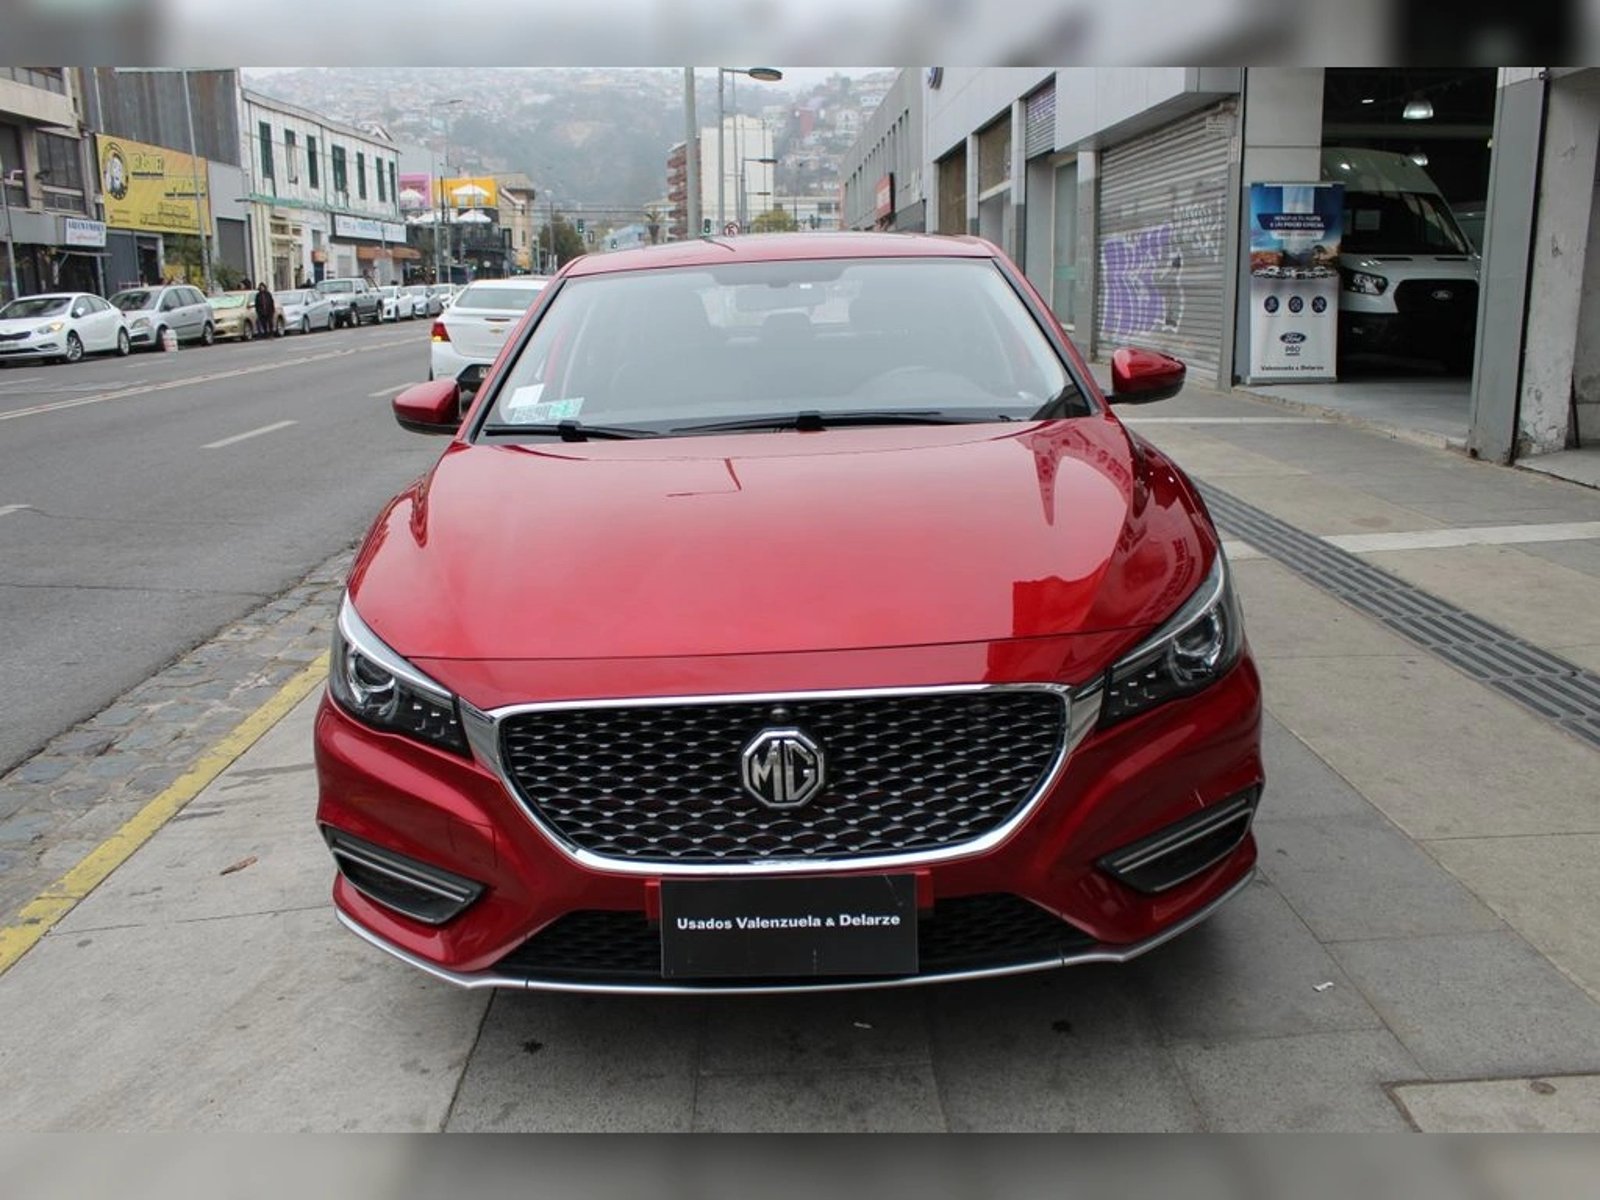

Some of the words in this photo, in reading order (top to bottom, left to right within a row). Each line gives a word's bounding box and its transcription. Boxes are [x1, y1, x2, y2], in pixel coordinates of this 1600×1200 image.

[749, 738, 817, 802] MG
[676, 917, 733, 931] Usados
[735, 915, 822, 930] Valenzuela
[825, 916, 836, 927] &
[839, 913, 901, 928] Delarze
